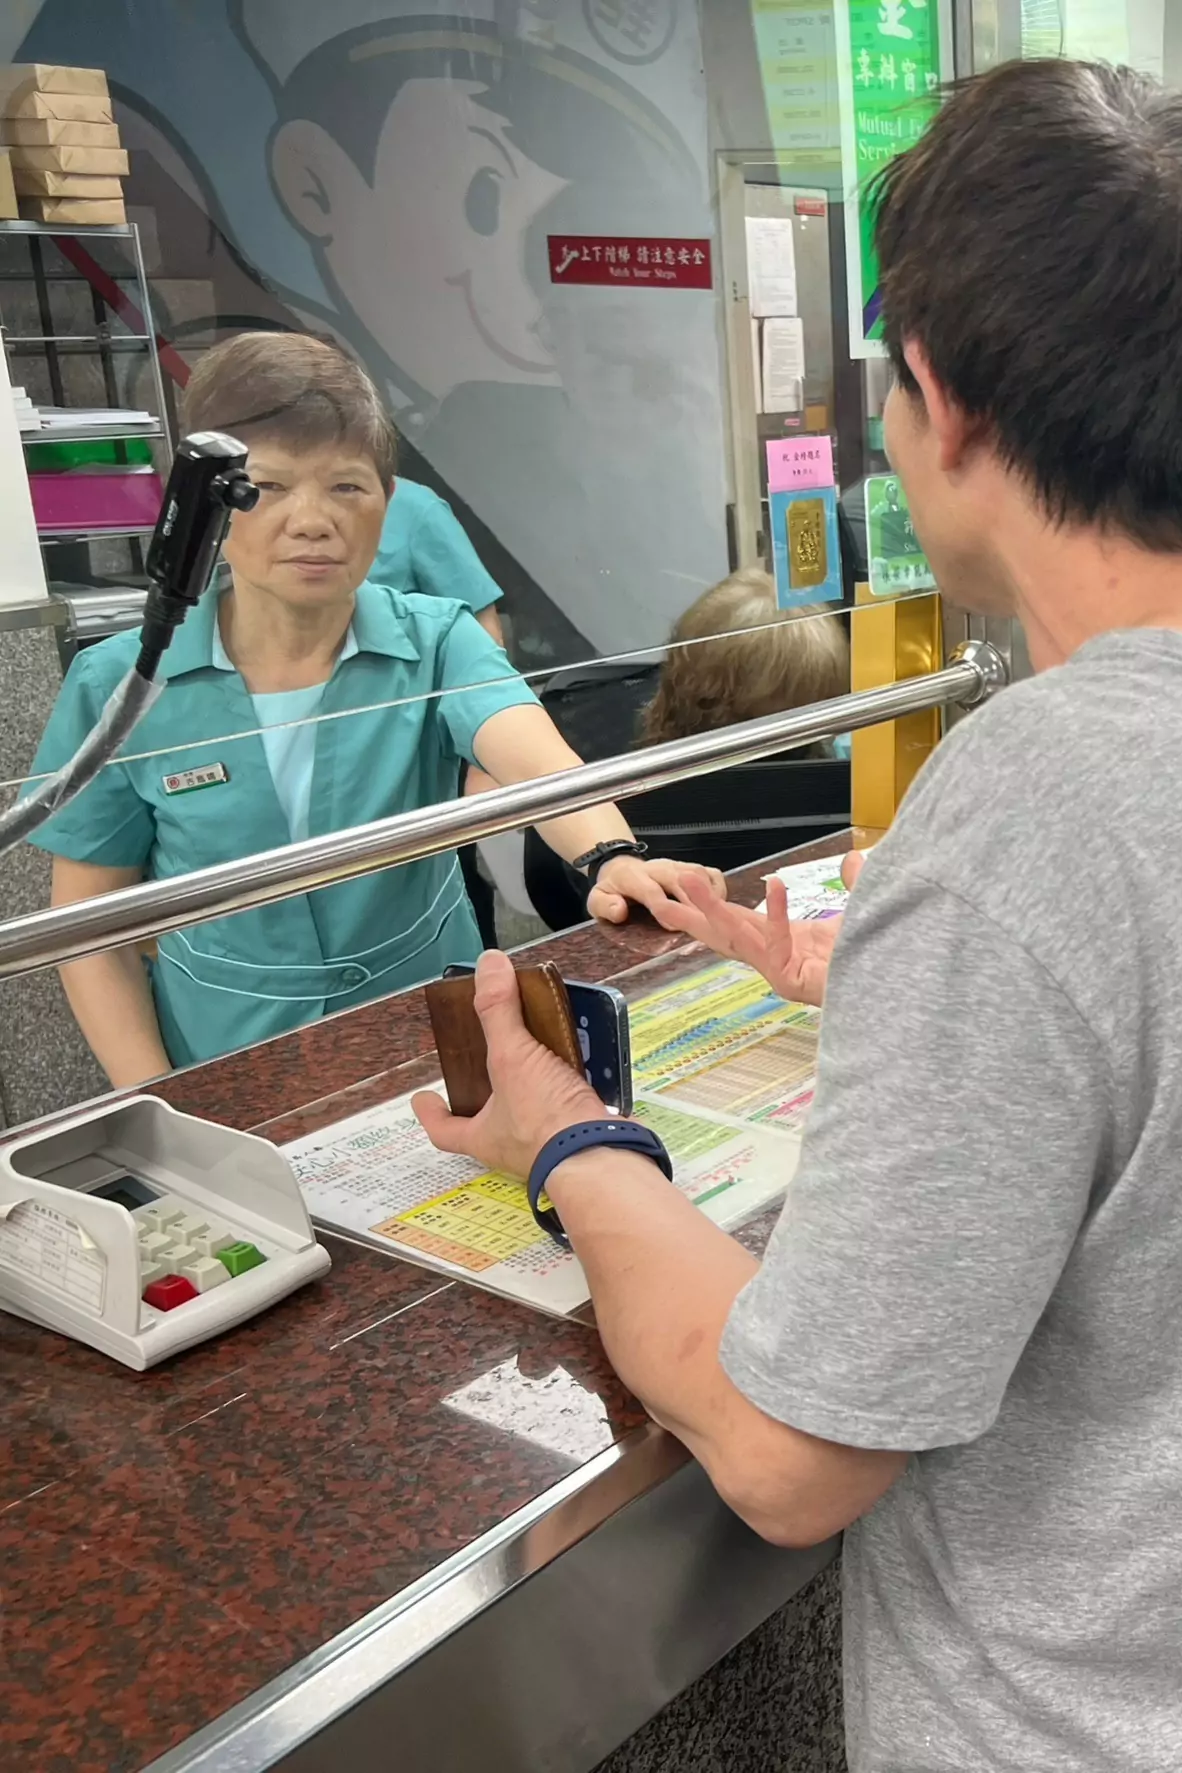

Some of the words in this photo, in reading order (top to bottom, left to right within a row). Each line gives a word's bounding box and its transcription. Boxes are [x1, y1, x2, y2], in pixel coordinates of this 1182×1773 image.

[858, 111, 902, 138] Mutual
[637, 247, 705, 266] 請注意安全
